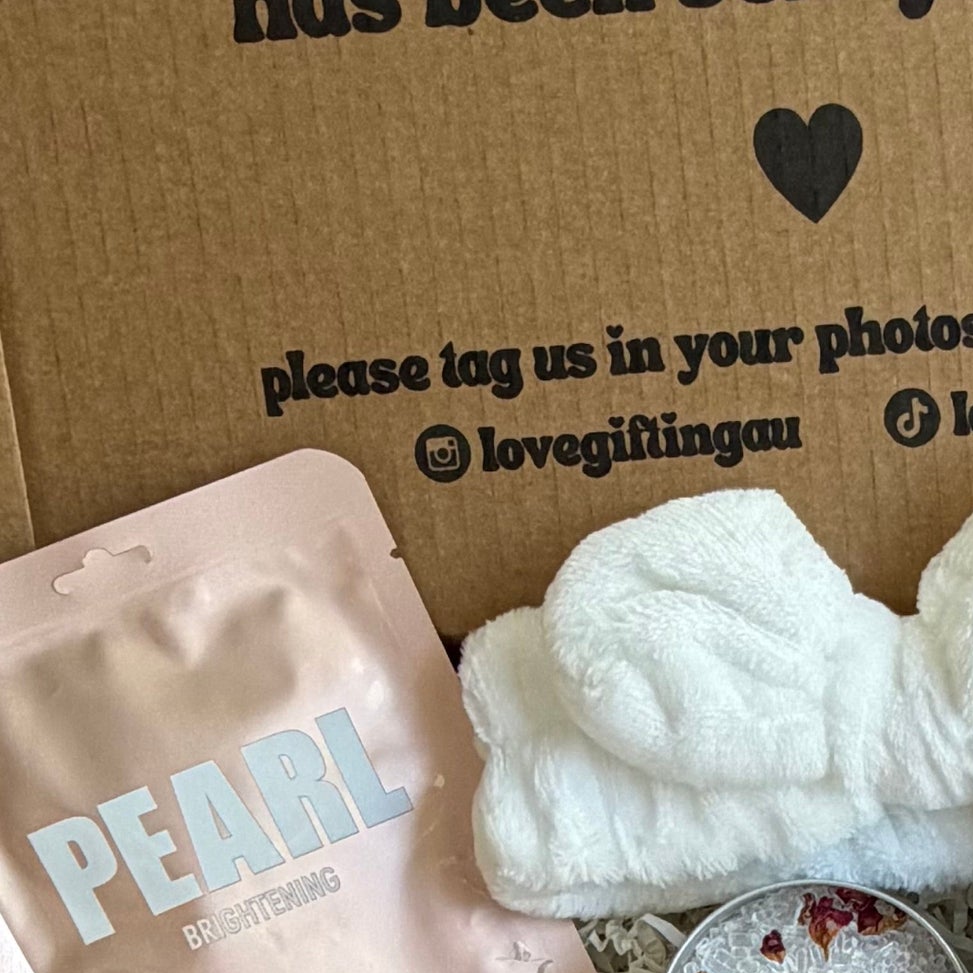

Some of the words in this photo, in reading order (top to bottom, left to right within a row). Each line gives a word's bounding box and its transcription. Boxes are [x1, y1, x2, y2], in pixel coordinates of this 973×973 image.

[261, 351, 430, 416] please
[441, 342, 523, 398] tag
[532, 342, 597, 380] us
[605, 325, 663, 374] in
[677, 328, 803, 383] your
[480, 411, 802, 477] lovegiftingau
[27, 707, 413, 945] PEARL
[182, 866, 341, 950] BRIGHTENING
